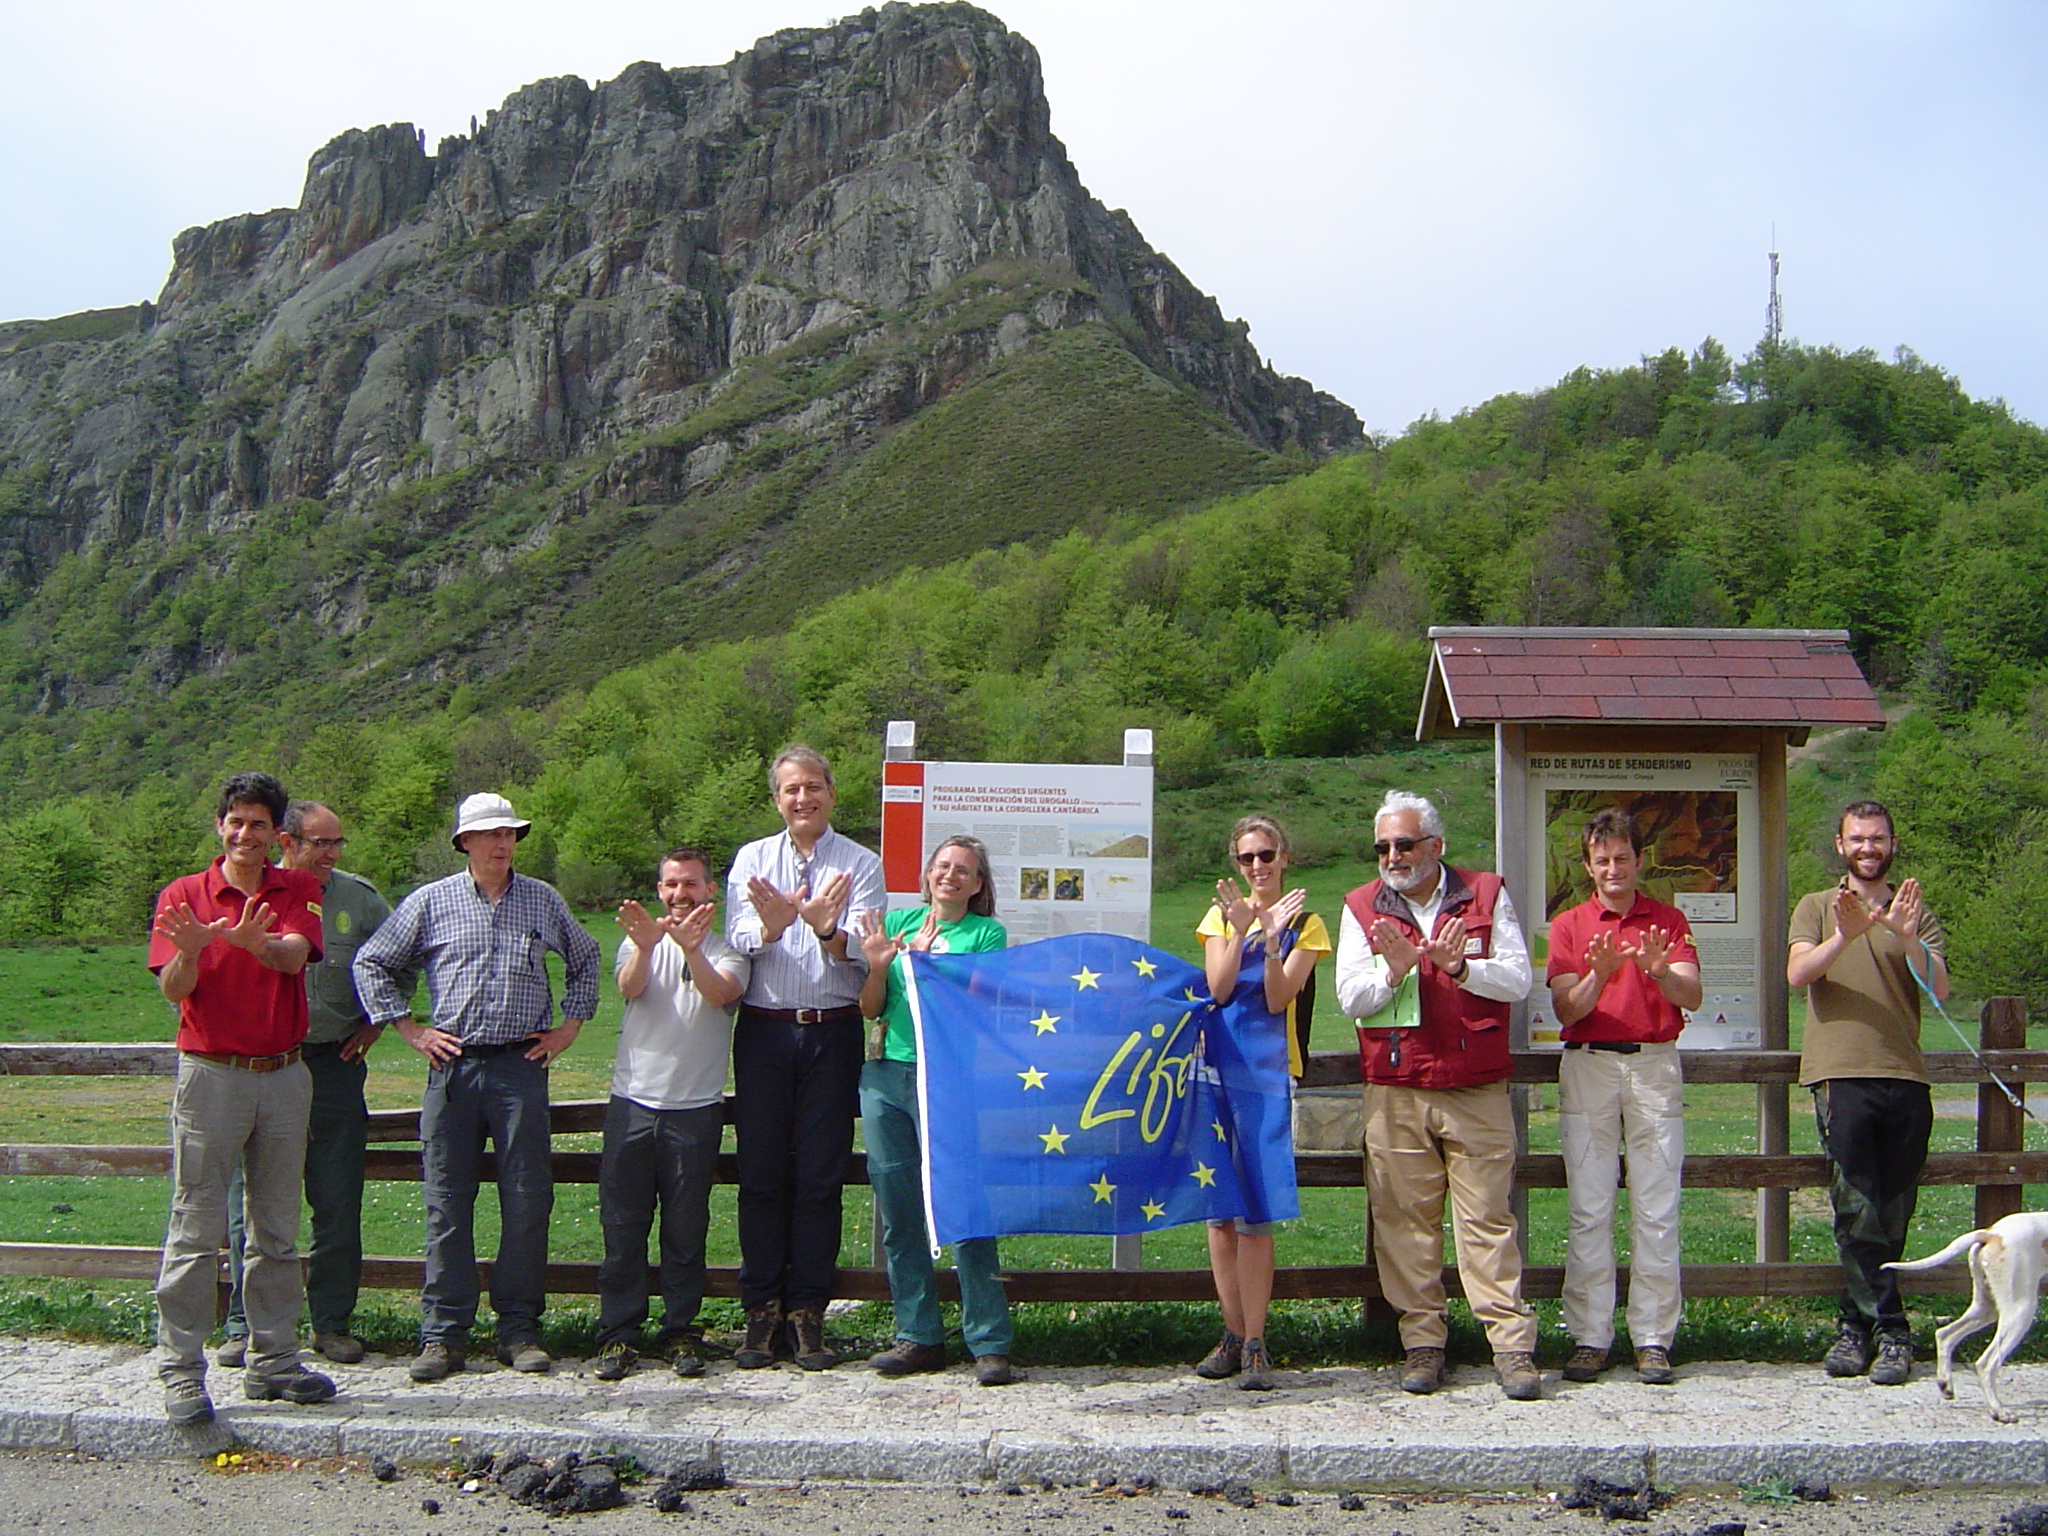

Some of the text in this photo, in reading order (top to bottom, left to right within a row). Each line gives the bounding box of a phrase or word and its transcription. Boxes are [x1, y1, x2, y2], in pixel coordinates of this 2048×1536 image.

[1530, 758, 1691, 770] RED DE RUTAS DE SENDERISMO
[965, 795, 1022, 803] CONSERVACIÓN
[951, 803, 982, 812] HÁBITAT
[1053, 806, 1099, 814] CANTÁBRICA
[1080, 1010, 1200, 1143] Life
